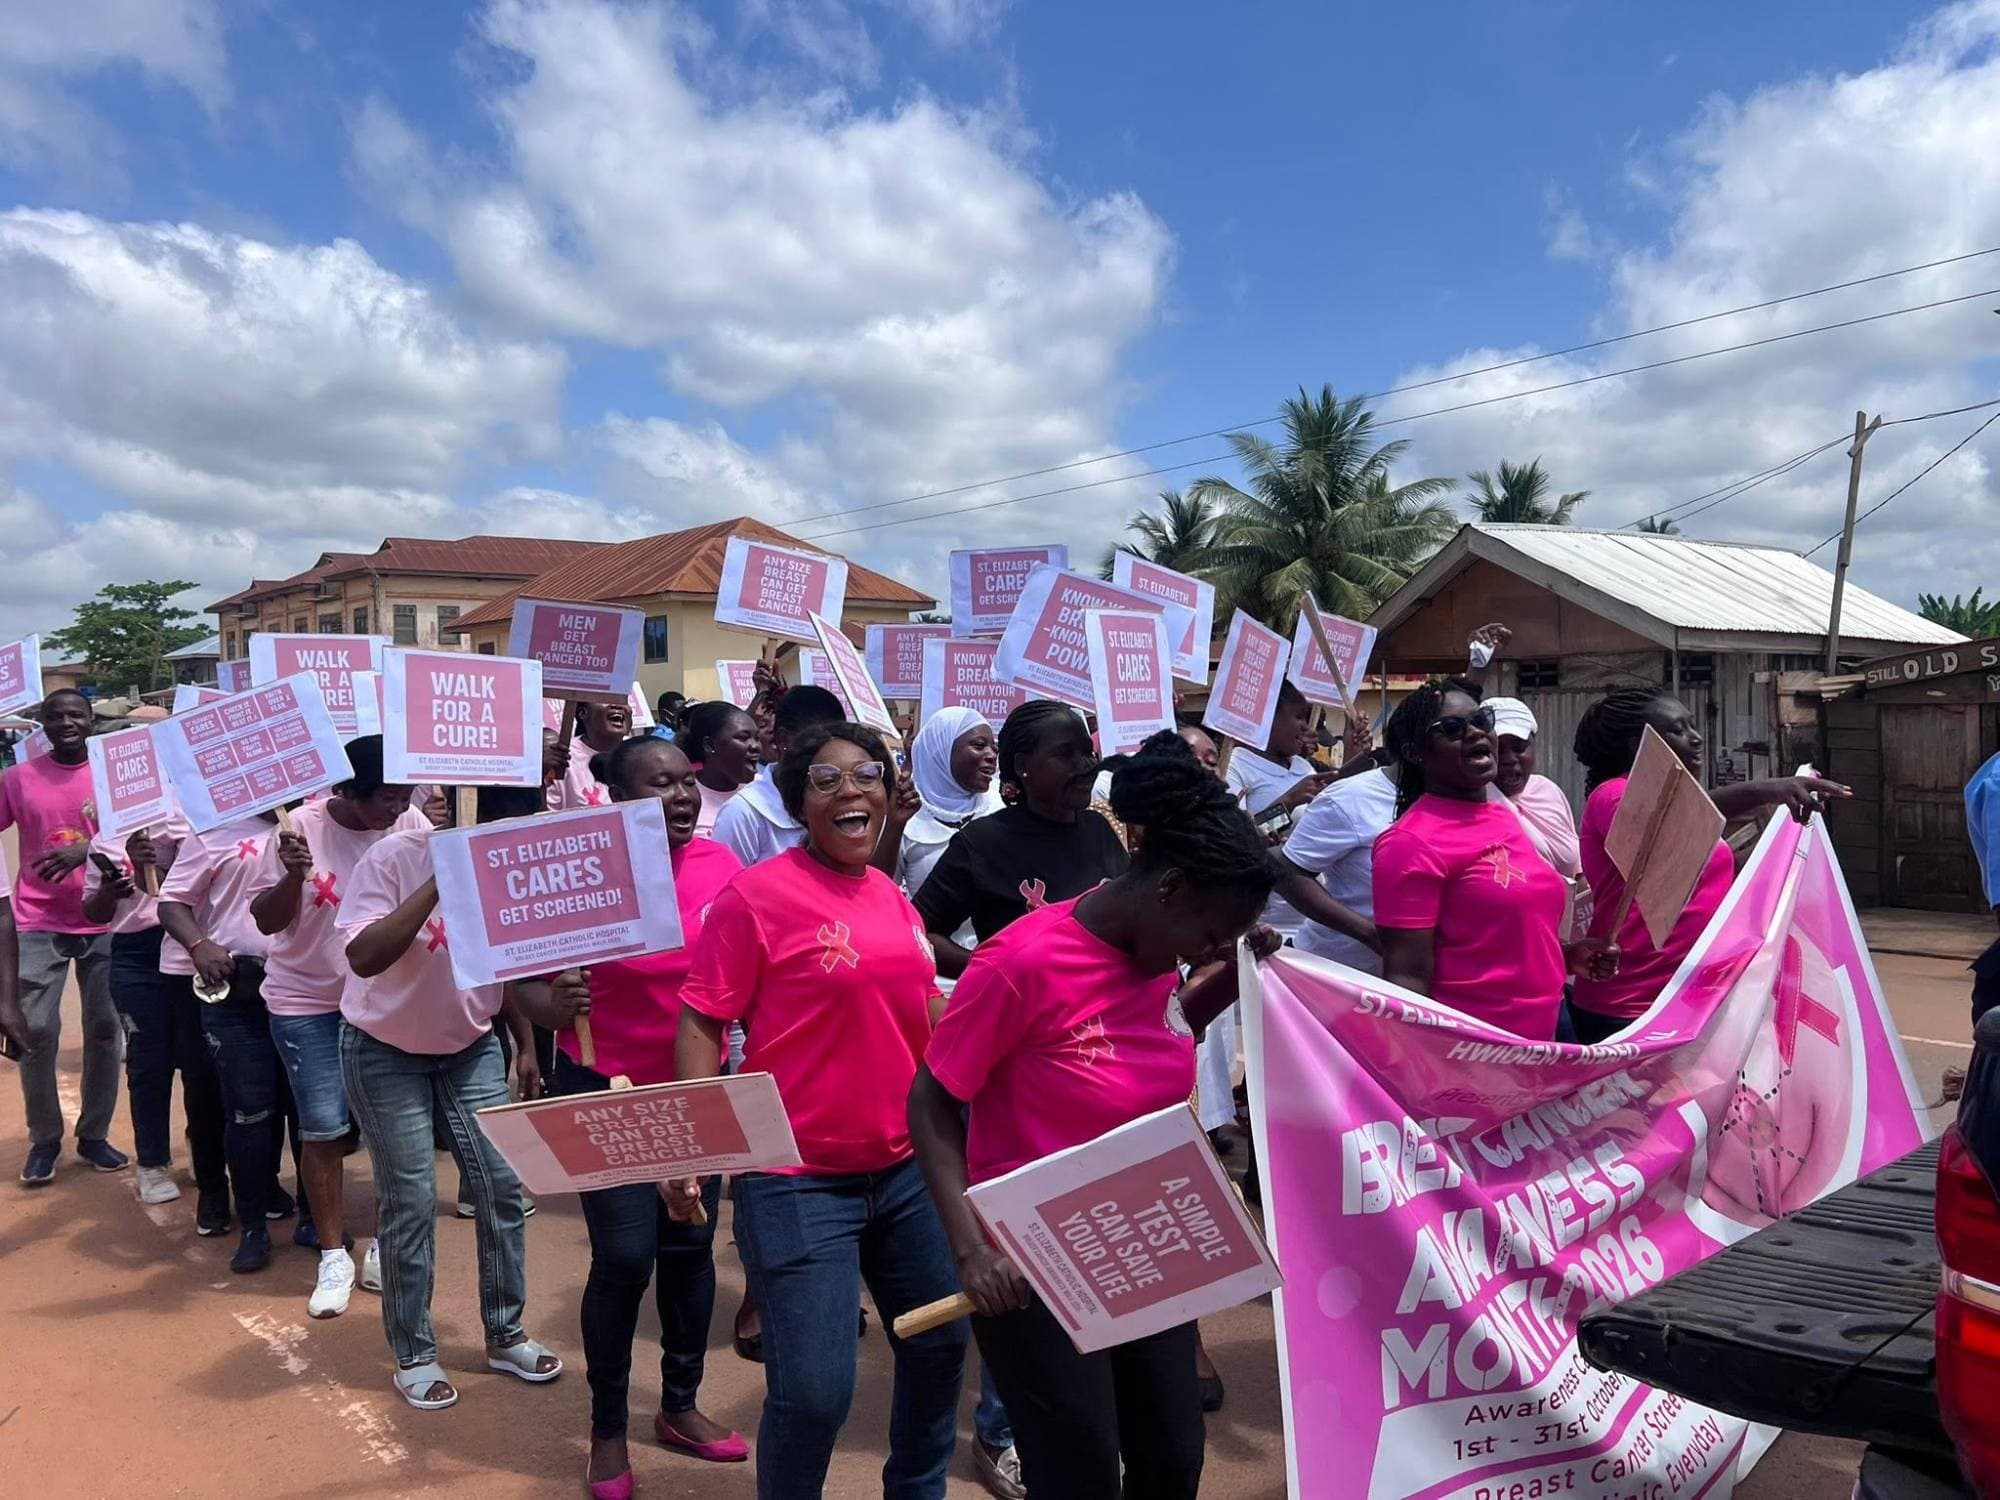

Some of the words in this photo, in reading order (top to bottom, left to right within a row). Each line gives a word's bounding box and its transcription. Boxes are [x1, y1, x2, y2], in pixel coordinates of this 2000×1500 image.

[763, 555, 786, 566] ANY
[788, 560, 812, 574] SIZE
[764, 566, 808, 584] BREAST
[978, 563, 990, 572] ST.
[760, 577, 784, 590] CAN
[786, 583, 807, 595] GET
[985, 574, 1028, 592] CARE
[1138, 577, 1149, 590] ST.
[1150, 582, 1189, 604] ELIZABETH
[758, 599, 802, 616] CANCER
[761, 588, 803, 605] BREAST
[979, 595, 994, 605] GET
[1061, 588, 1105, 608] KNOW
[559, 614, 596, 631] MEN
[564, 630, 588, 642] GET
[896, 633, 915, 642] ANY
[1108, 631, 1120, 648] ST.
[1120, 631, 1153, 648] ELIZABETH
[1246, 632, 1258, 650] ANY
[296, 650, 350, 668] WALK
[550, 641, 597, 655] BREAST
[897, 652, 916, 661] CAN
[954, 653, 986, 665] KNOW
[1046, 644, 1091, 674] POW
[536, 652, 582, 665] CANCER
[586, 656, 608, 668] TOO
[1117, 654, 1151, 682] CARES
[1244, 648, 1266, 671] BREAST
[1868, 666, 1900, 684] STILL
[1904, 651, 1960, 680] OLD
[339, 671, 350, 686] A
[430, 672, 496, 699] WALK
[1238, 664, 1252, 682] CAN
[1250, 670, 1264, 685] GET
[989, 686, 1016, 696] YOUR
[1115, 688, 1126, 704] GET
[1236, 679, 1259, 702] BREAST
[432, 700, 470, 722] FOR
[480, 702, 494, 723] A
[1232, 694, 1256, 716] CANCER
[433, 724, 498, 748] CURE!
[108, 747, 119, 760] ST.
[119, 738, 150, 757] ELIZABETH
[116, 755, 150, 781] CARES
[114, 785, 126, 799] GET
[486, 848, 514, 868] ST.
[520, 830, 612, 864] ELIZABETH
[506, 856, 605, 900] CARES
[499, 907, 530, 926] GET
[534, 888, 622, 920] SCREENED!
[504, 948, 516, 956] ST.
[518, 940, 558, 954] ELIZABETH
[559, 932, 594, 946] CATHOLIC
[595, 926, 630, 939] HOSPITAL
[1353, 990, 1394, 1018] ST.
[1446, 1041, 1561, 1065] HWIDIEM
[574, 1105, 624, 1124] ANY
[632, 1096, 691, 1118] SIZE
[586, 1110, 684, 1134] BREAST
[588, 1126, 643, 1145] CAN
[650, 1122, 696, 1138] GET
[601, 1134, 696, 1156] BREAST
[604, 1146, 704, 1166] CANCER
[1160, 1176, 1191, 1194] A
[1133, 1199, 1191, 1257] TEST
[1172, 1194, 1232, 1262] SIMPLE
[1058, 1211, 1106, 1264] YOUR
[1090, 1256, 1132, 1299] LIFE
[1090, 1200, 1129, 1244] CAN
[1116, 1242, 1164, 1288] SAVE
[1567, 1214, 1665, 1308] 2026
[1034, 1232, 1062, 1264] ELIZABETH
[1057, 1263, 1082, 1290] CATHOLIC
[1076, 1288, 1099, 1314] HOSPITAL
[1464, 1368, 1581, 1426] Awareness
[1453, 1436, 1497, 1460] 1st
[1535, 1413, 1589, 1445] 31st
[1590, 1430, 1656, 1483] Cancer
[1666, 1414, 1724, 1494] Everyday
